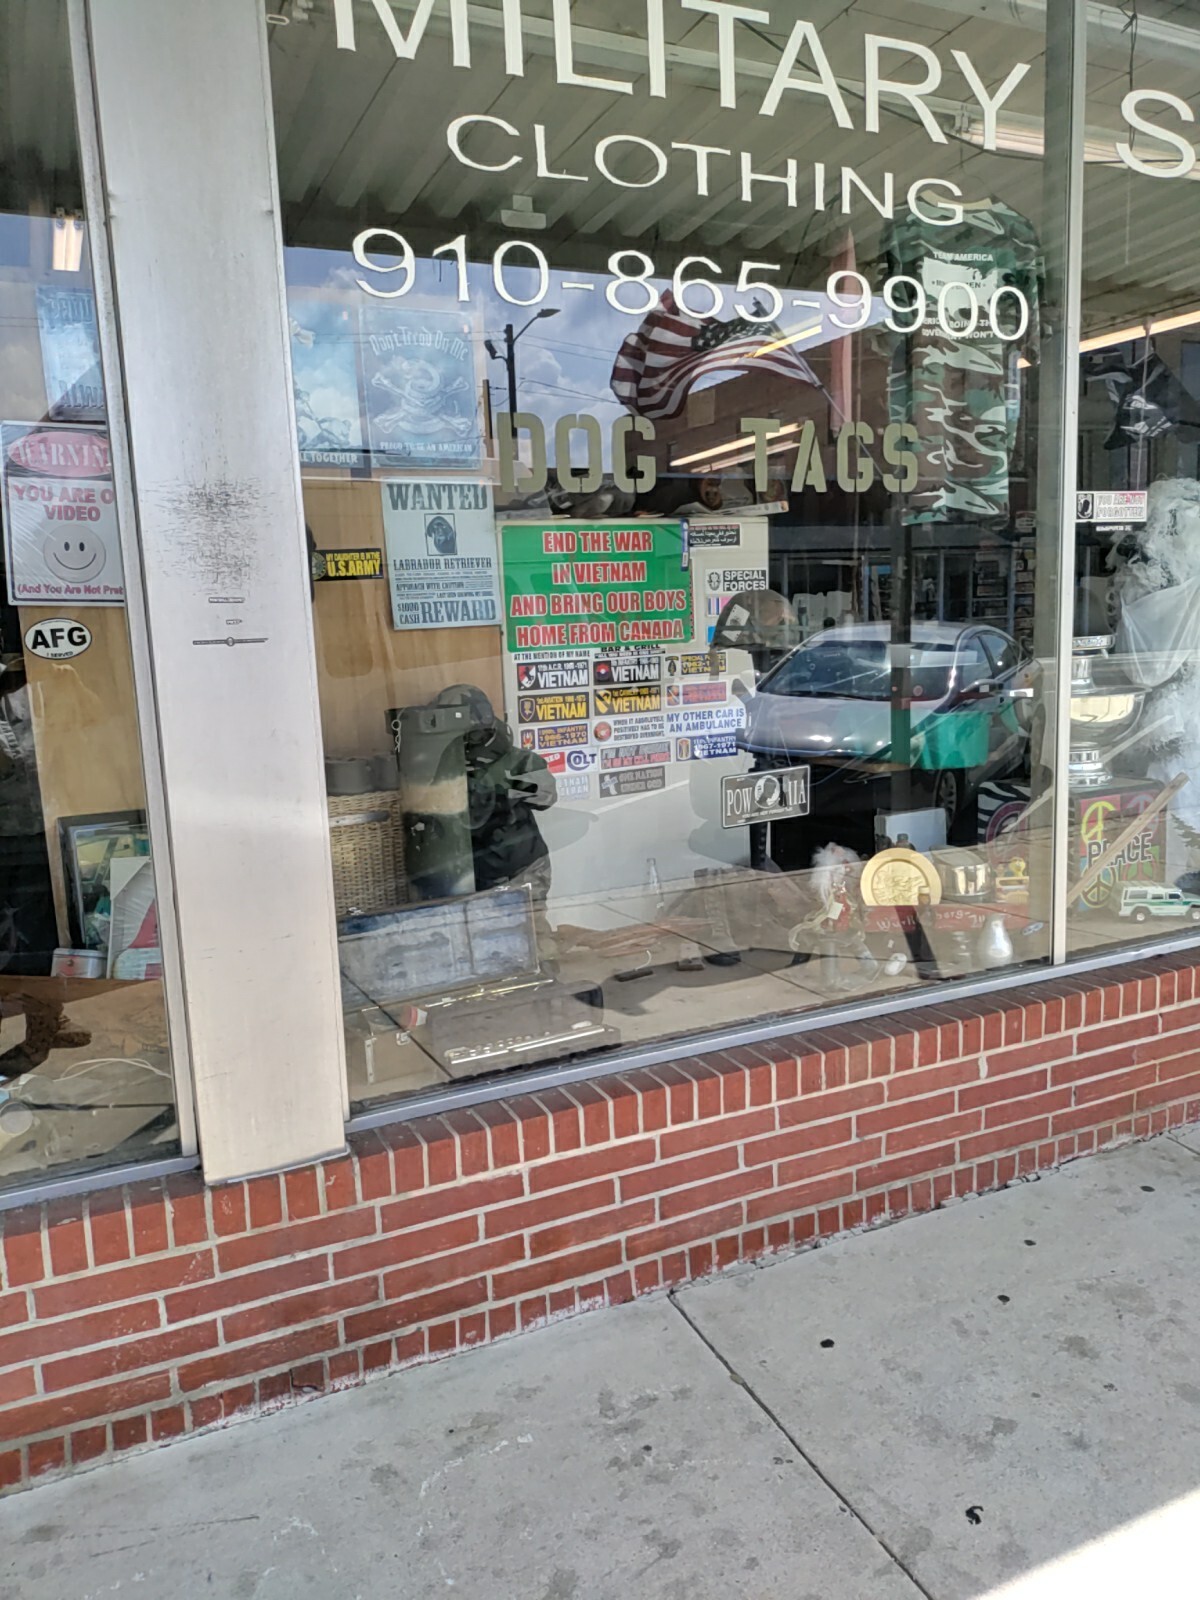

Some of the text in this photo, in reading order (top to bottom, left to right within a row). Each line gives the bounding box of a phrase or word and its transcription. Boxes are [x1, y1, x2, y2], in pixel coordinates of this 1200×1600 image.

[446, 114, 964, 226] CLOTHING
[351, 228, 1030, 342] 910-865-9900
[17, 441, 111, 467] WARNIN
[497, 412, 919, 494] DOG TAGS
[13, 484, 54, 501] YOU
[59, 487, 96, 504] ARE
[387, 483, 488, 510] WANTED
[43, 505, 101, 521] VIDEO
[543, 530, 653, 554] END THE WAR
[444, 557, 492, 570] RETRIEVER
[552, 561, 647, 584] IN VIETNAM
[724, 570, 764, 580] SPECIAL
[724, 581, 766, 591] FORCES
[420, 599, 497, 624] REWARD
[510, 589, 686, 617] AND BRING OUR BOYS
[31, 626, 87, 650] AFG
[516, 619, 684, 648] HOME FROM CANADA
[537, 669, 589, 689] VIETNAM
[611, 664, 660, 682] VIETNAM
[682, 665, 726, 674] VIETNM
[536, 702, 586, 720] VIETNAM
[612, 695, 660, 713] VIETNAM
[666, 708, 744, 723] MY OTHER CAR IS
[670, 718, 742, 732] AN AMBULANCE
[539, 737, 586, 748] VIETNAM
[567, 750, 597, 771] COLT
[726, 787, 753, 816] POW
